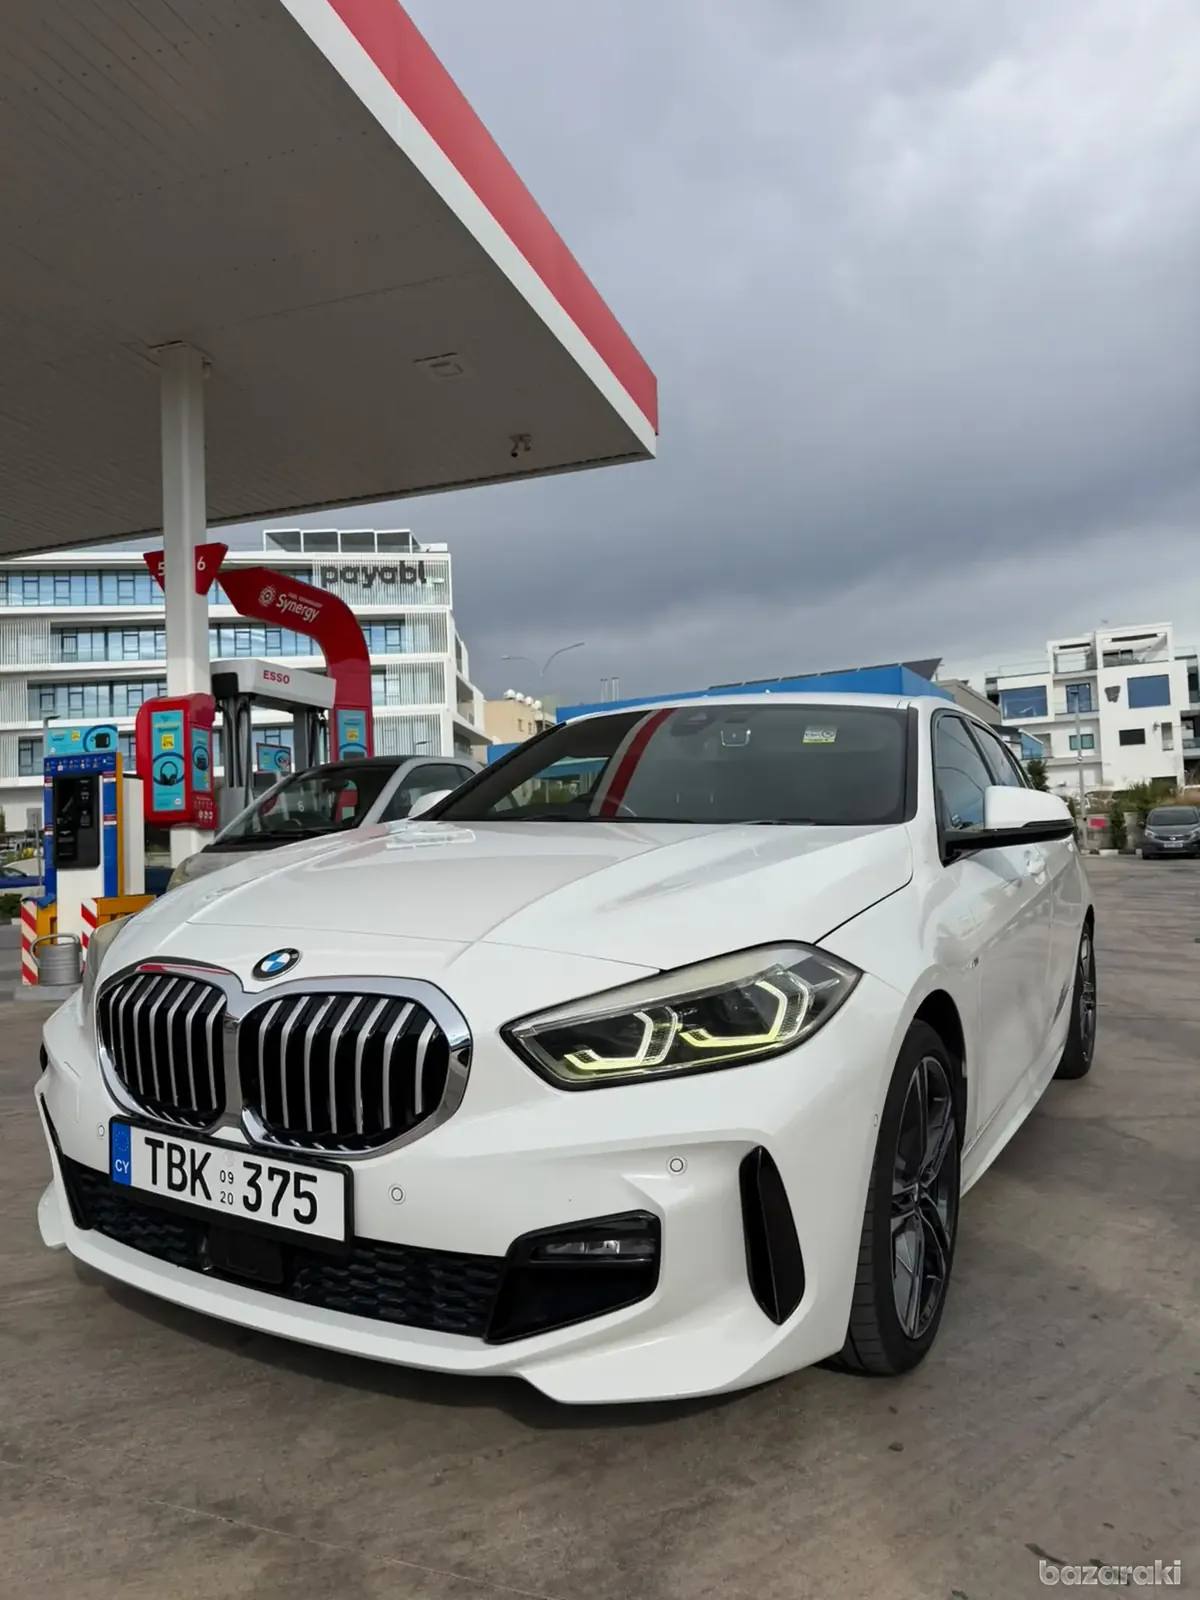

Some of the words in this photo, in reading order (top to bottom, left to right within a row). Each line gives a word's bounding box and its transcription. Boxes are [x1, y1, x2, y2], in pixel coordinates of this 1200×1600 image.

[197, 556, 206, 571] 6
[276, 593, 320, 623] Synergy
[263, 669, 291, 685] ESSO
[115, 1159, 129, 1174] CY
[144, 1136, 212, 1201] TBK
[242, 1161, 318, 1225] 375
[220, 1169, 234, 1185] 09
[220, 1190, 234, 1206] 20
